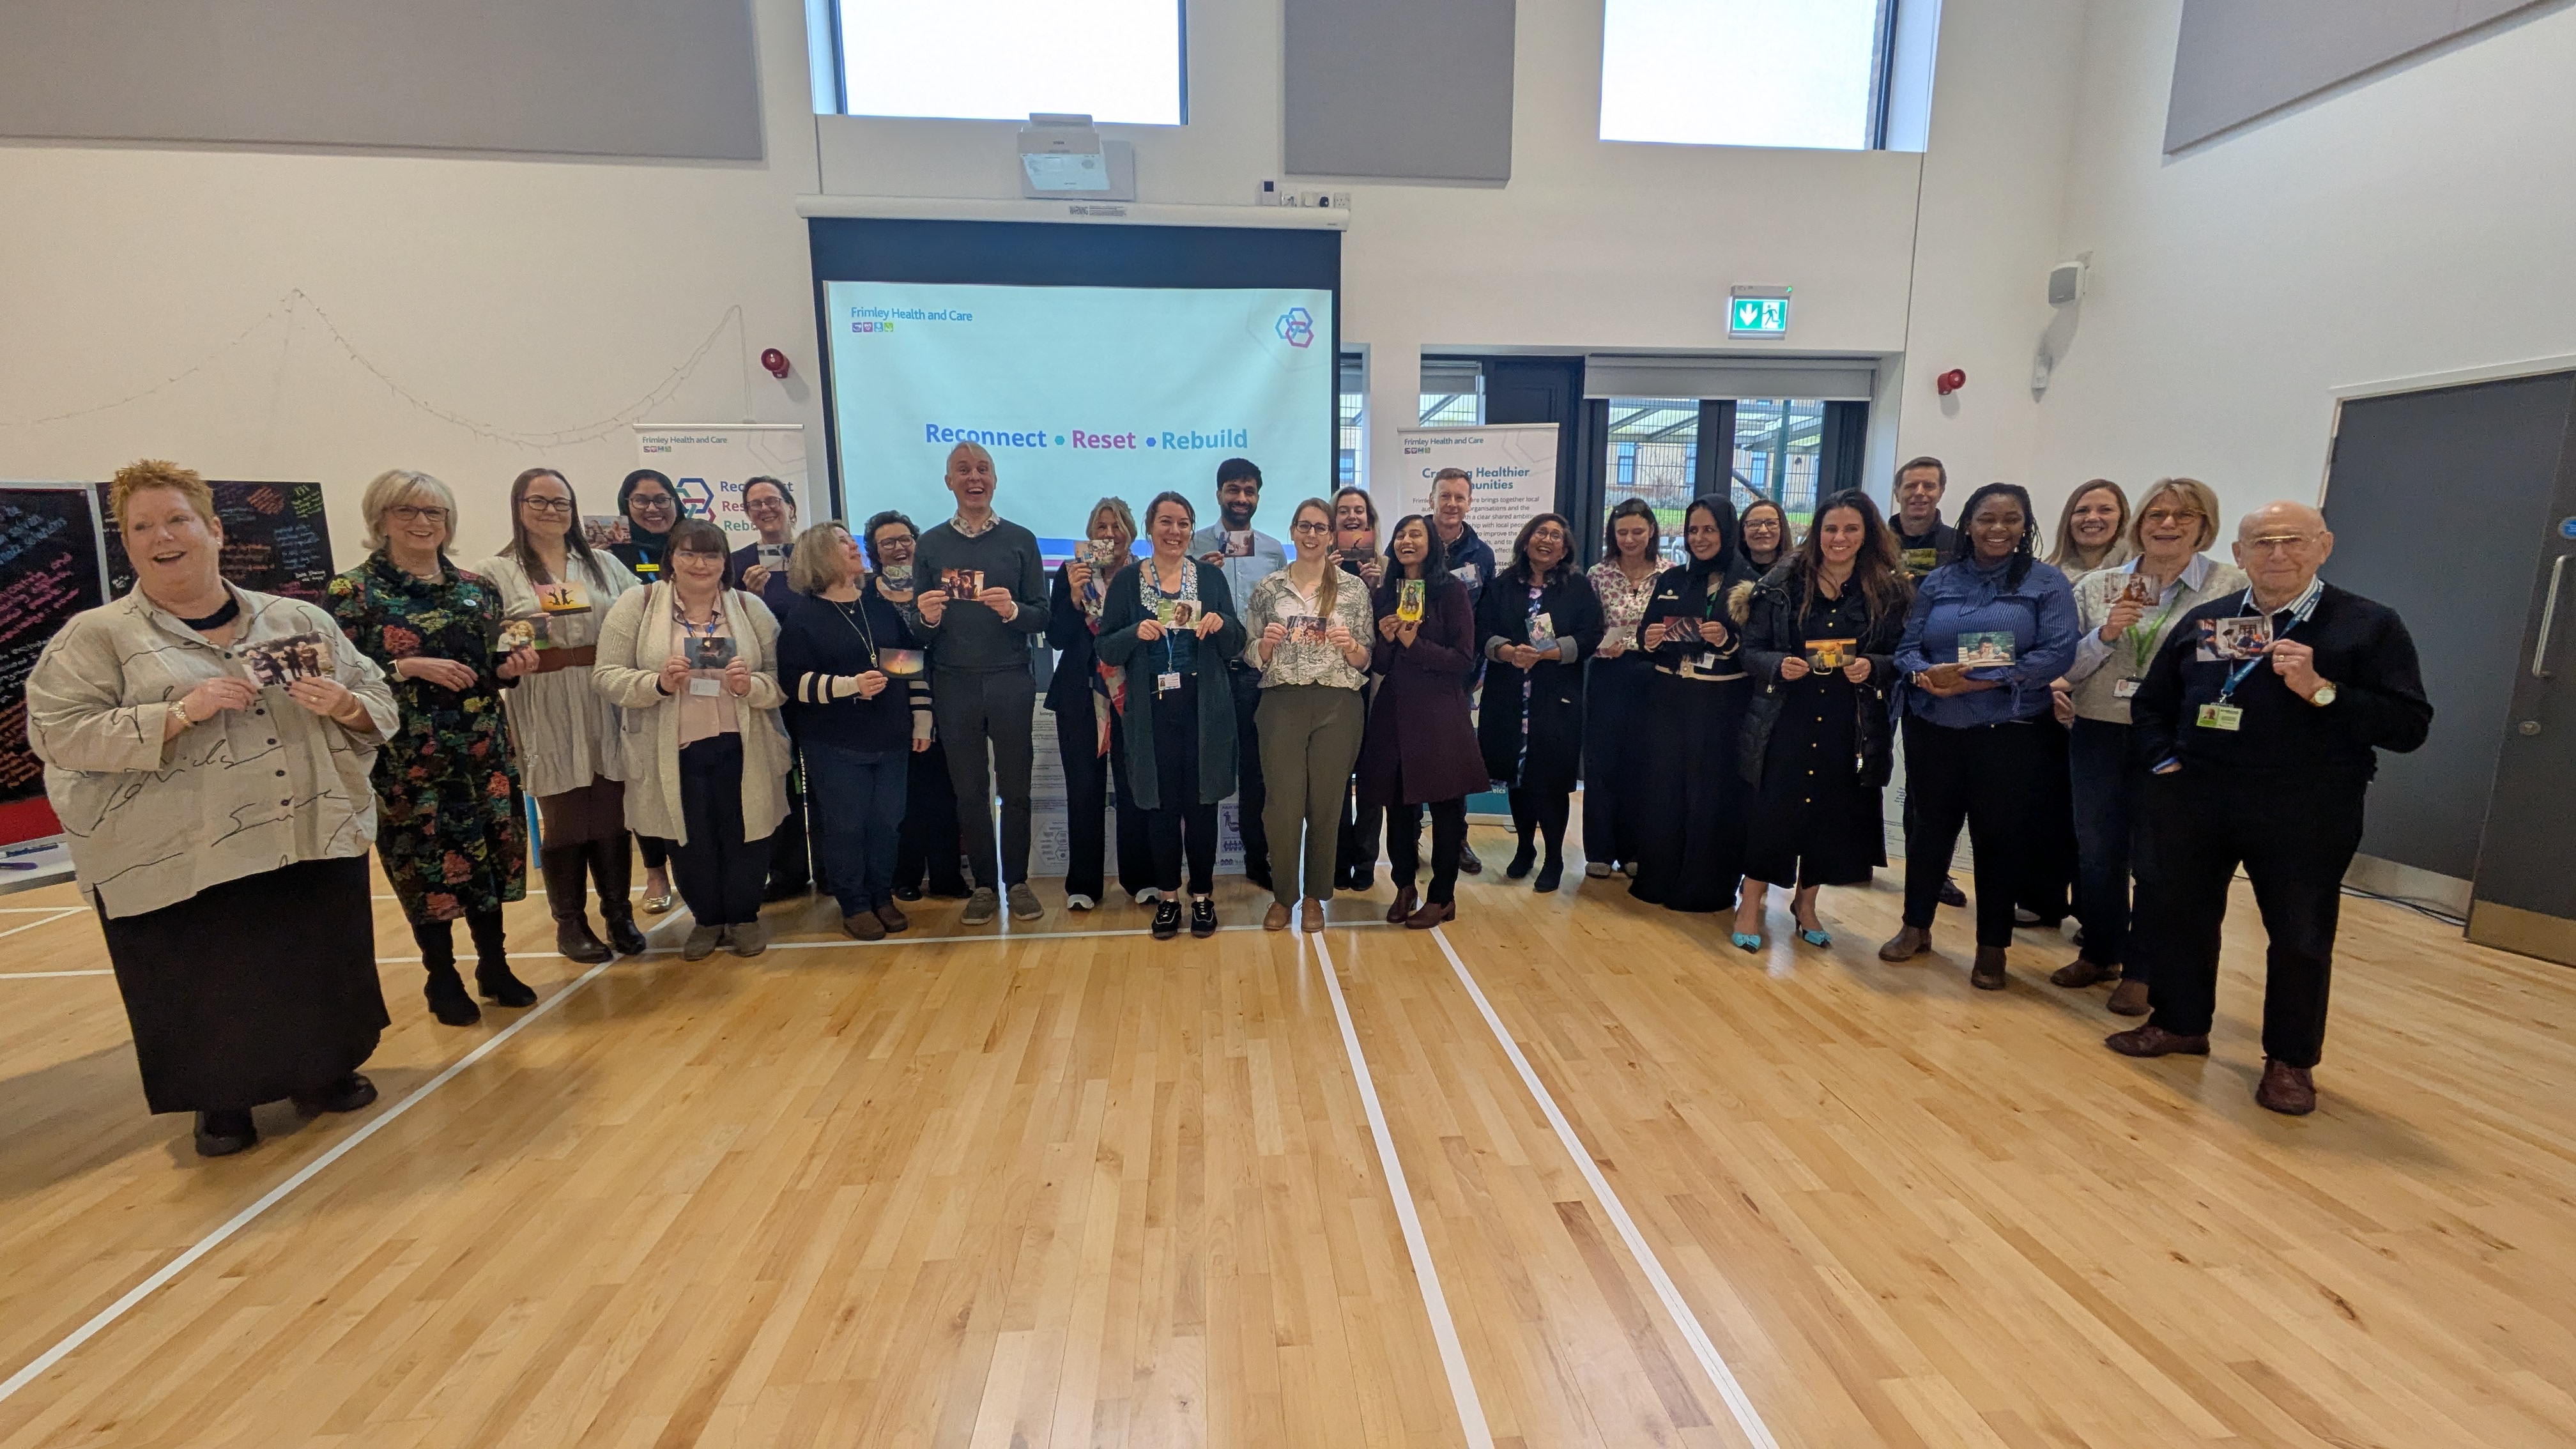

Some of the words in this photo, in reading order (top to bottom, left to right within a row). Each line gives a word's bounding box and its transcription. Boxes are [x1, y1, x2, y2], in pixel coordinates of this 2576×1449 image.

[852, 307, 889, 320] Frimley
[892, 308, 925, 319] Health
[928, 309, 946, 321] and
[949, 310, 972, 321] Care
[643, 436, 668, 445] Frimley
[926, 424, 1047, 447] Reconnect
[1072, 430, 1137, 449] Reset
[1162, 429, 1248, 449] Rebuild
[1404, 438, 1429, 447] Frimley
[1476, 466, 1530, 477] Healthier
[1471, 479, 1514, 489] unities
[722, 501, 745, 511] Res
[724, 520, 758, 531] Rebu
